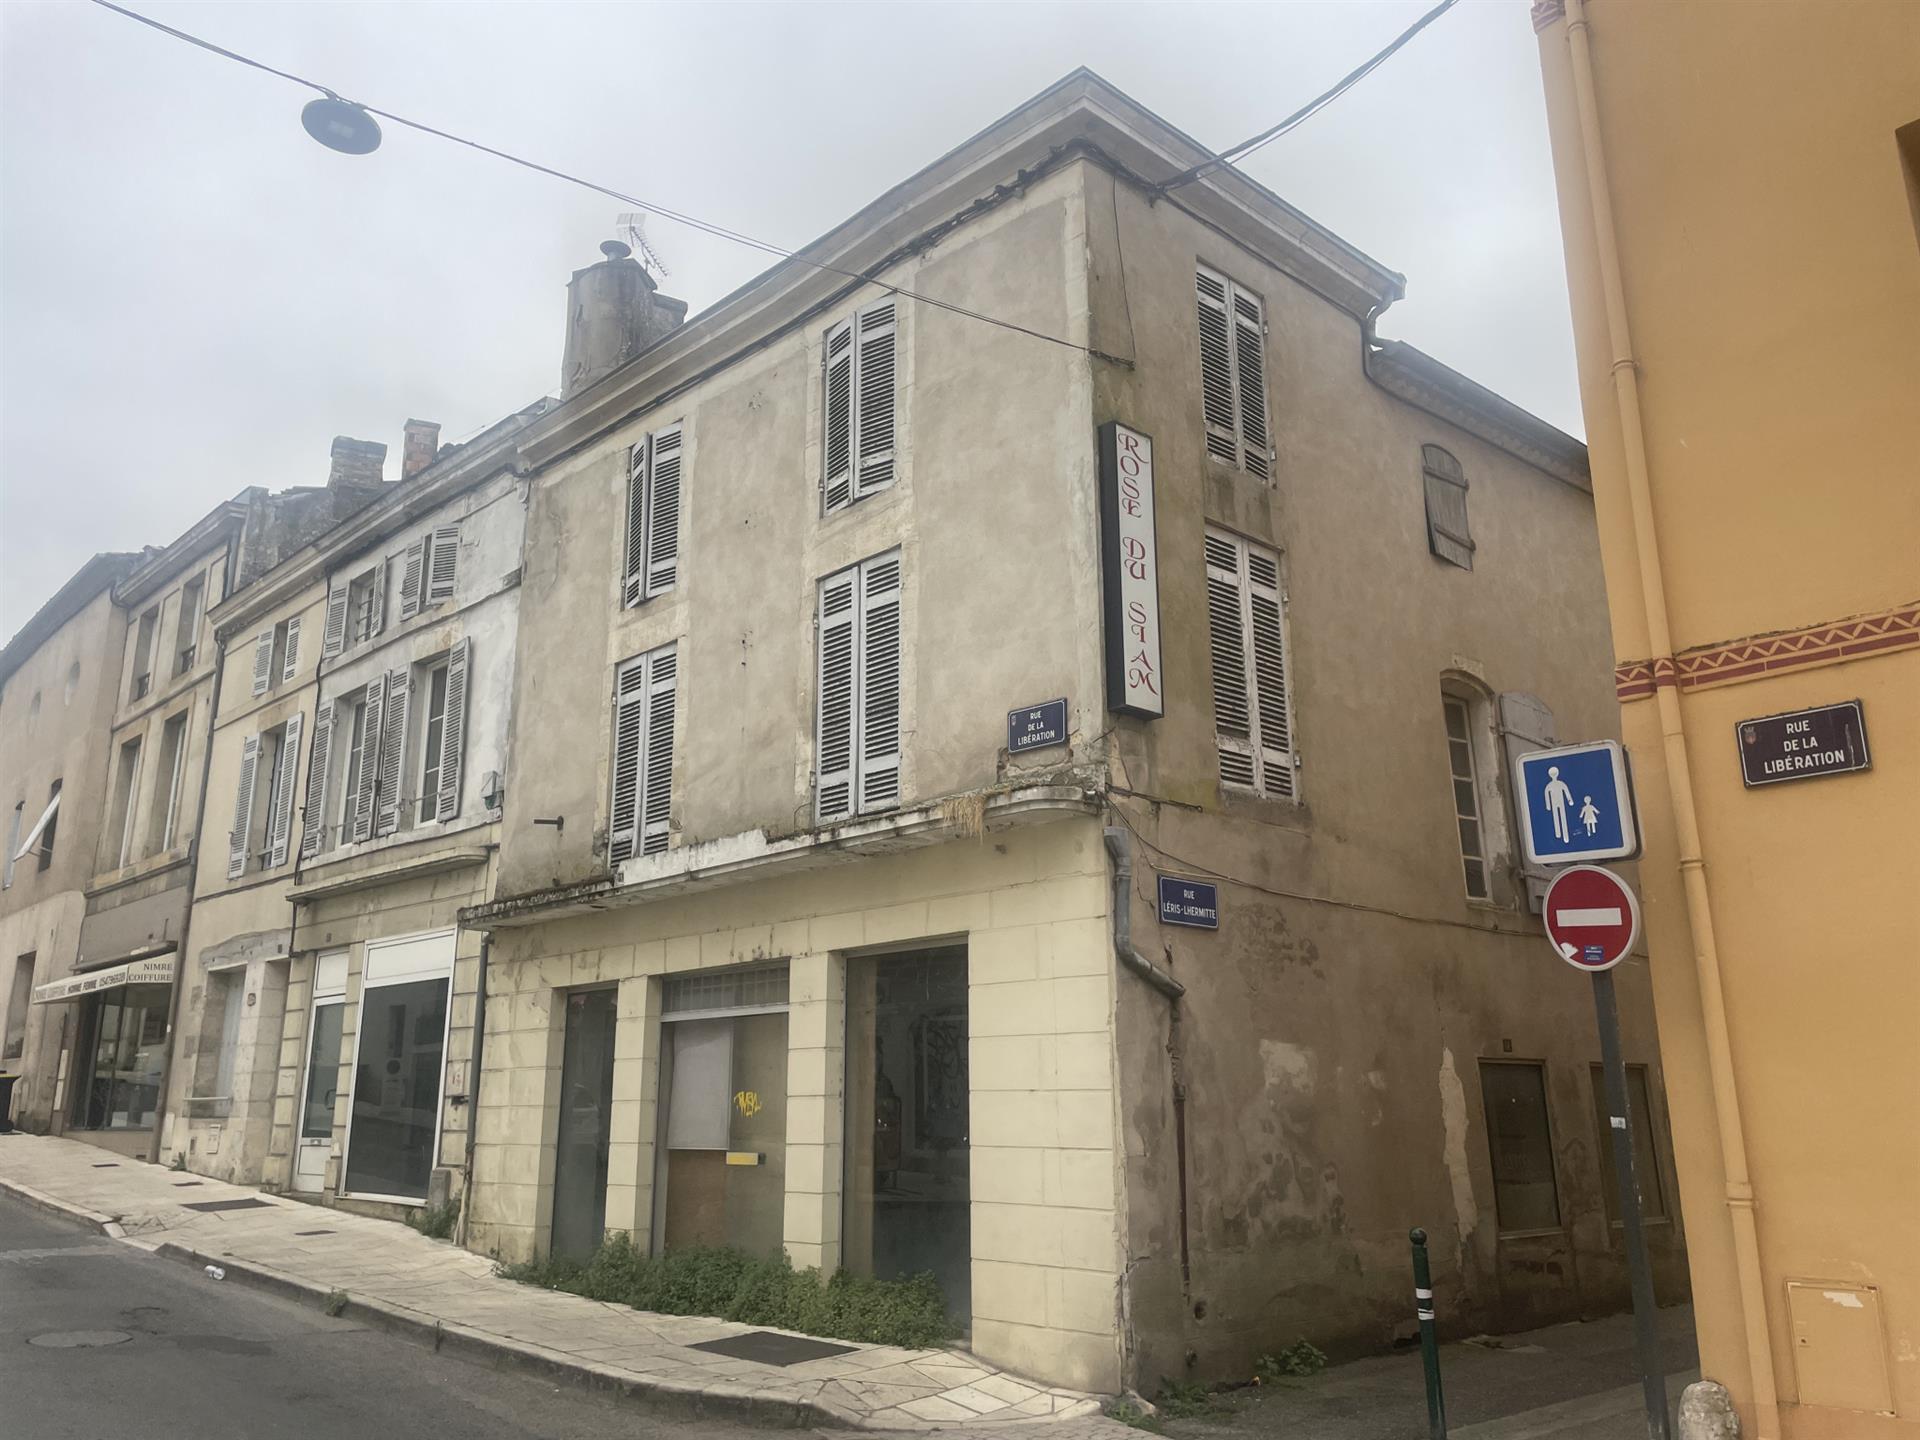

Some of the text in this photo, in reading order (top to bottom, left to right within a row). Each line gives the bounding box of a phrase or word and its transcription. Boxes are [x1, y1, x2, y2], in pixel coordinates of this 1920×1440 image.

[1117, 433, 1149, 518] ROSE
[1122, 536, 1147, 581] DU
[1030, 710, 1042, 720] RUE
[1027, 721, 1044, 732] DE LA
[1785, 720, 1811, 734] RUE
[1017, 729, 1055, 746] LIBÉRATION
[1783, 736, 1818, 752] DE LA
[1764, 749, 1845, 774] LIBÉRATION
[1183, 889, 1195, 900] RUE
[1163, 901, 1216, 919] LÉRIS-LHERMITTE
[128, 973, 173, 981] COIFFURE
